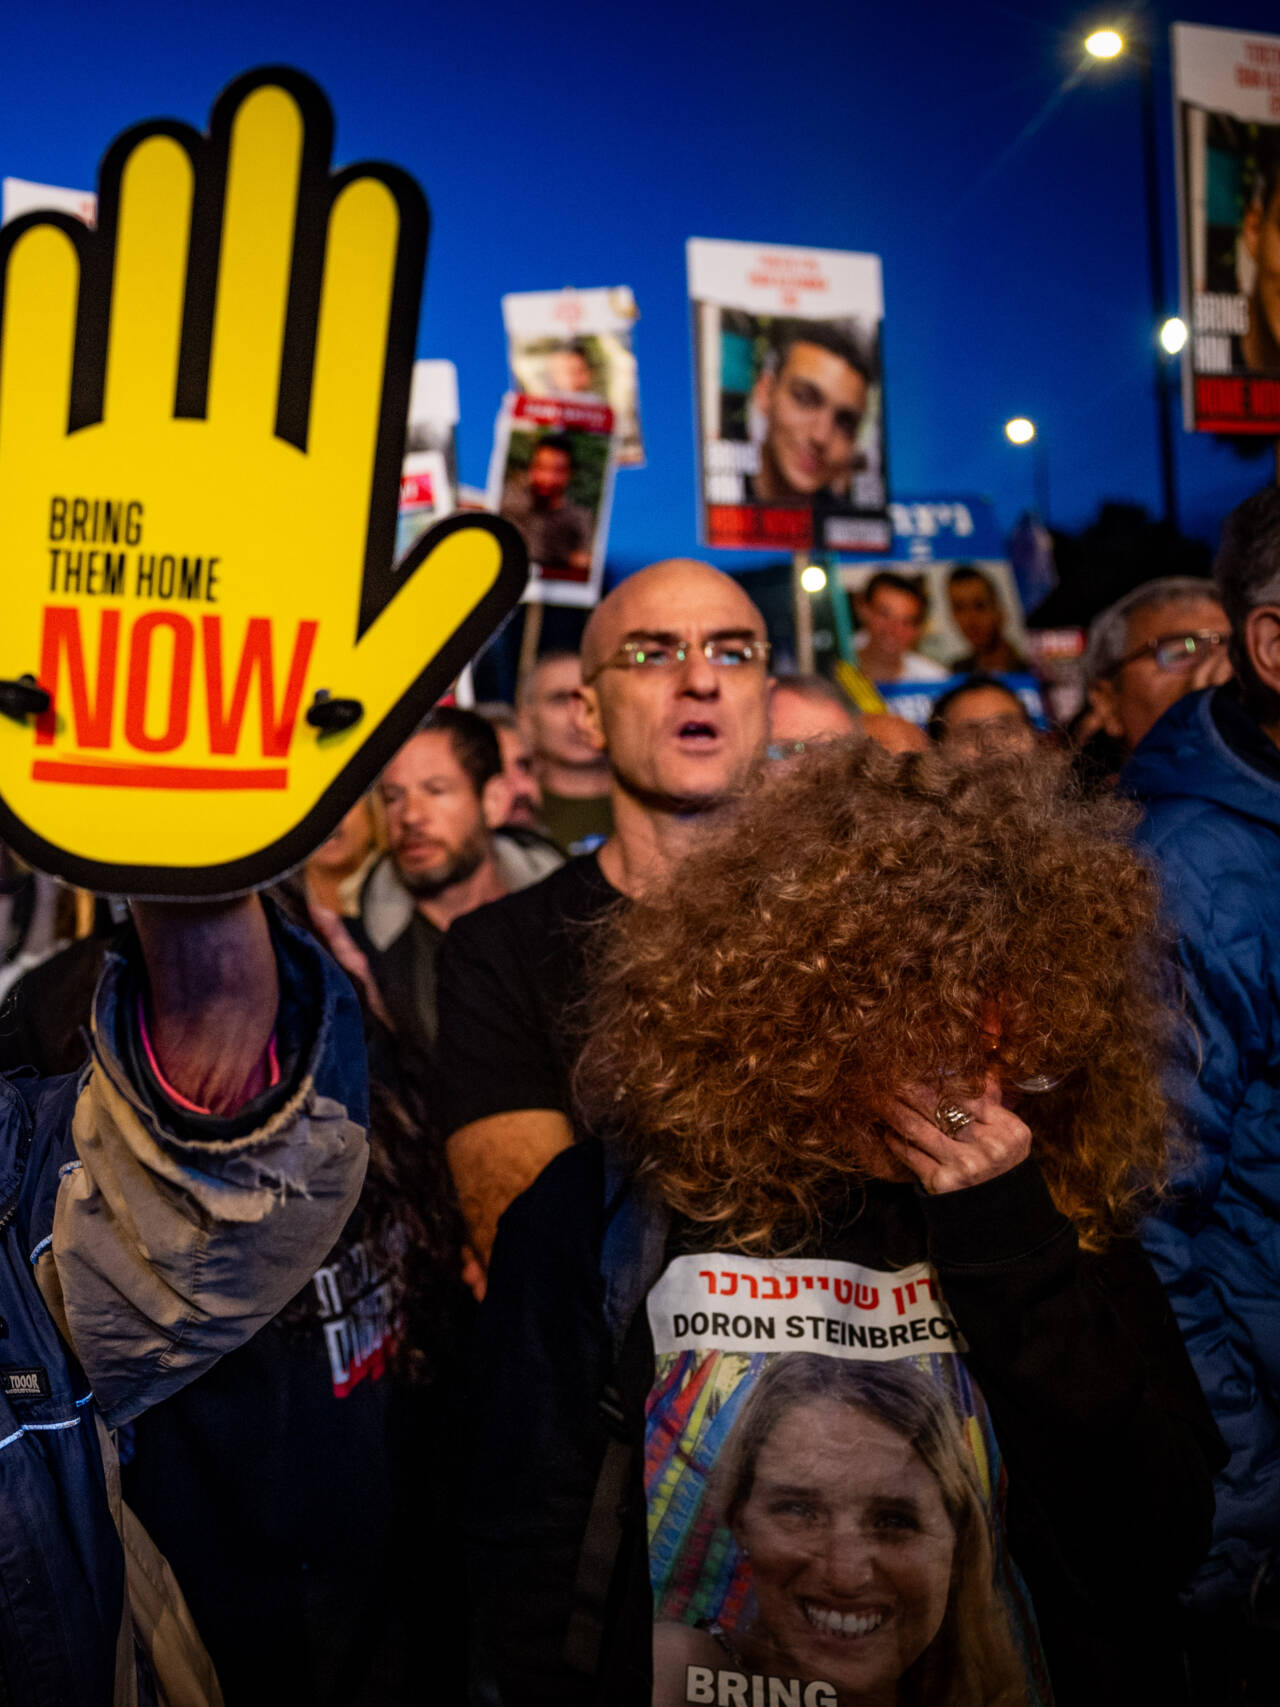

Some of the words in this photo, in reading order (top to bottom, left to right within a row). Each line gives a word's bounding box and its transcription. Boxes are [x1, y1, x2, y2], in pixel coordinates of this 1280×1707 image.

[49, 496, 144, 546] BRING
[49, 548, 126, 597] THEM
[136, 555, 221, 602] HOME
[34, 605, 320, 759] NOW
[699, 1270, 880, 1311] שטיינברכר
[673, 1312, 775, 1339] DORON
[686, 1664, 838, 1707] BRING
